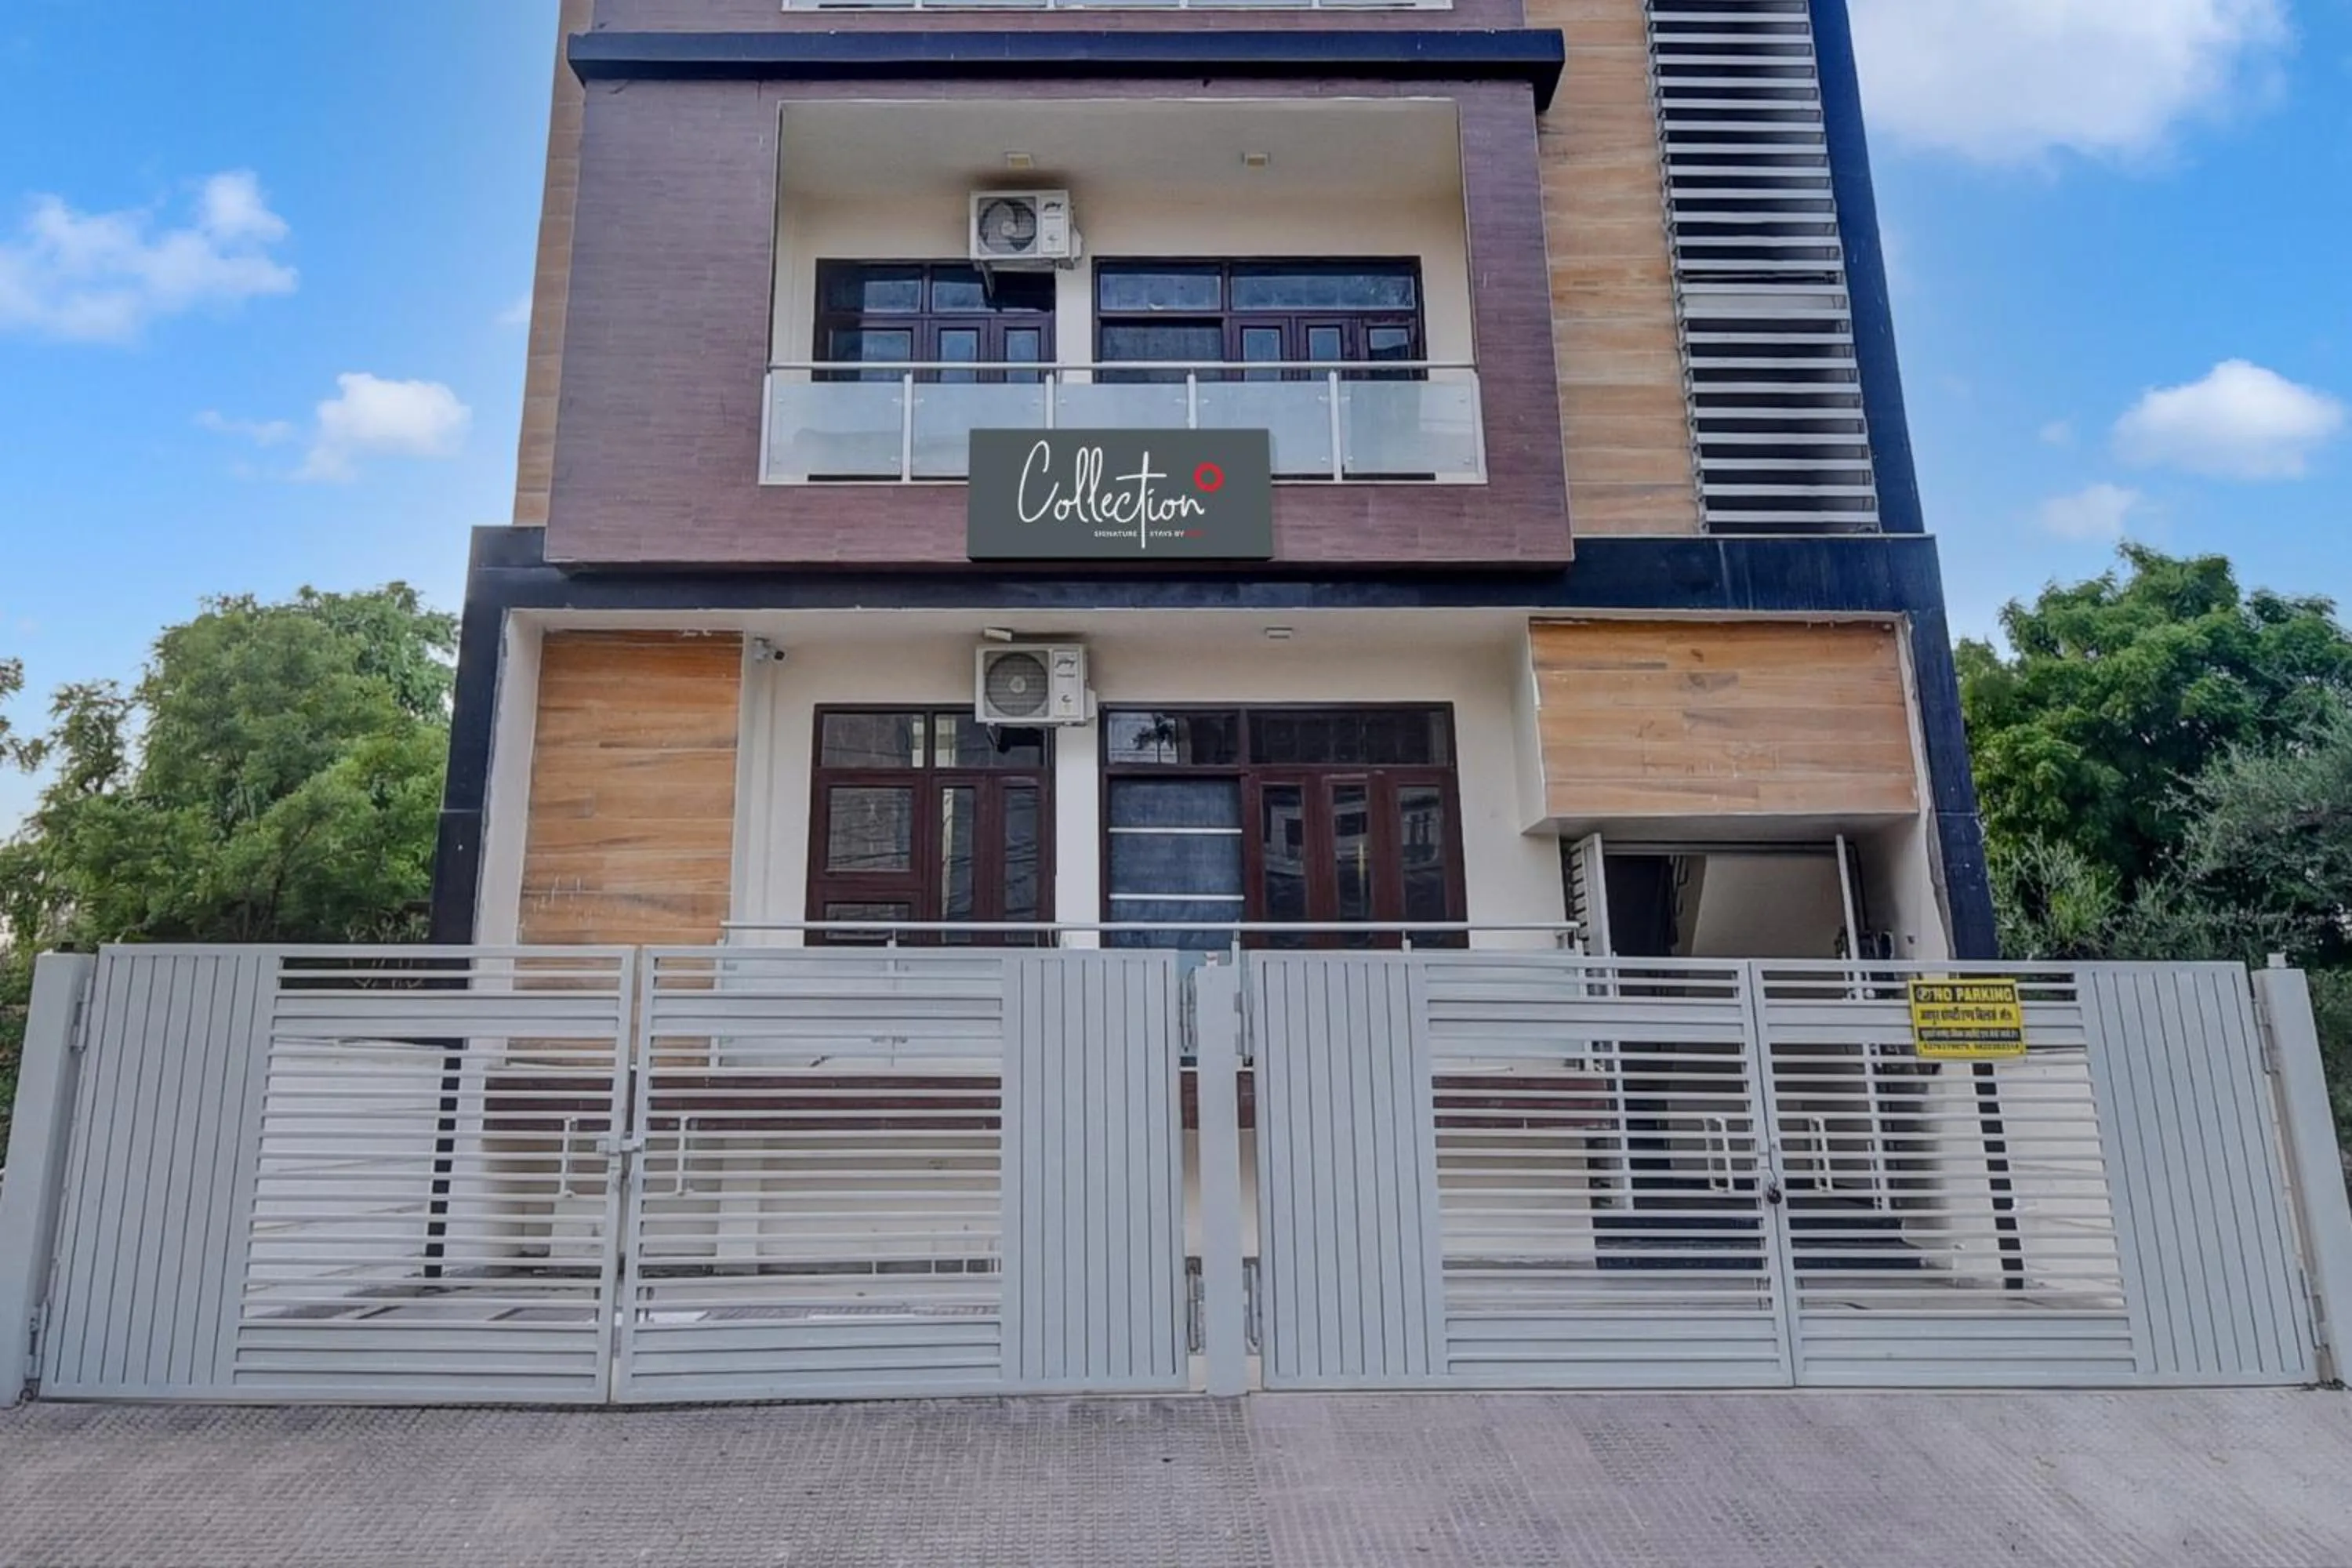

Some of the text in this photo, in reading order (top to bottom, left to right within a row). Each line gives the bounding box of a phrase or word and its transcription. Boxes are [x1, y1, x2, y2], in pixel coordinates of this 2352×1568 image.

[1018, 440, 1205, 549] Collection
[1934, 986, 2013, 1002] NO PARKING
